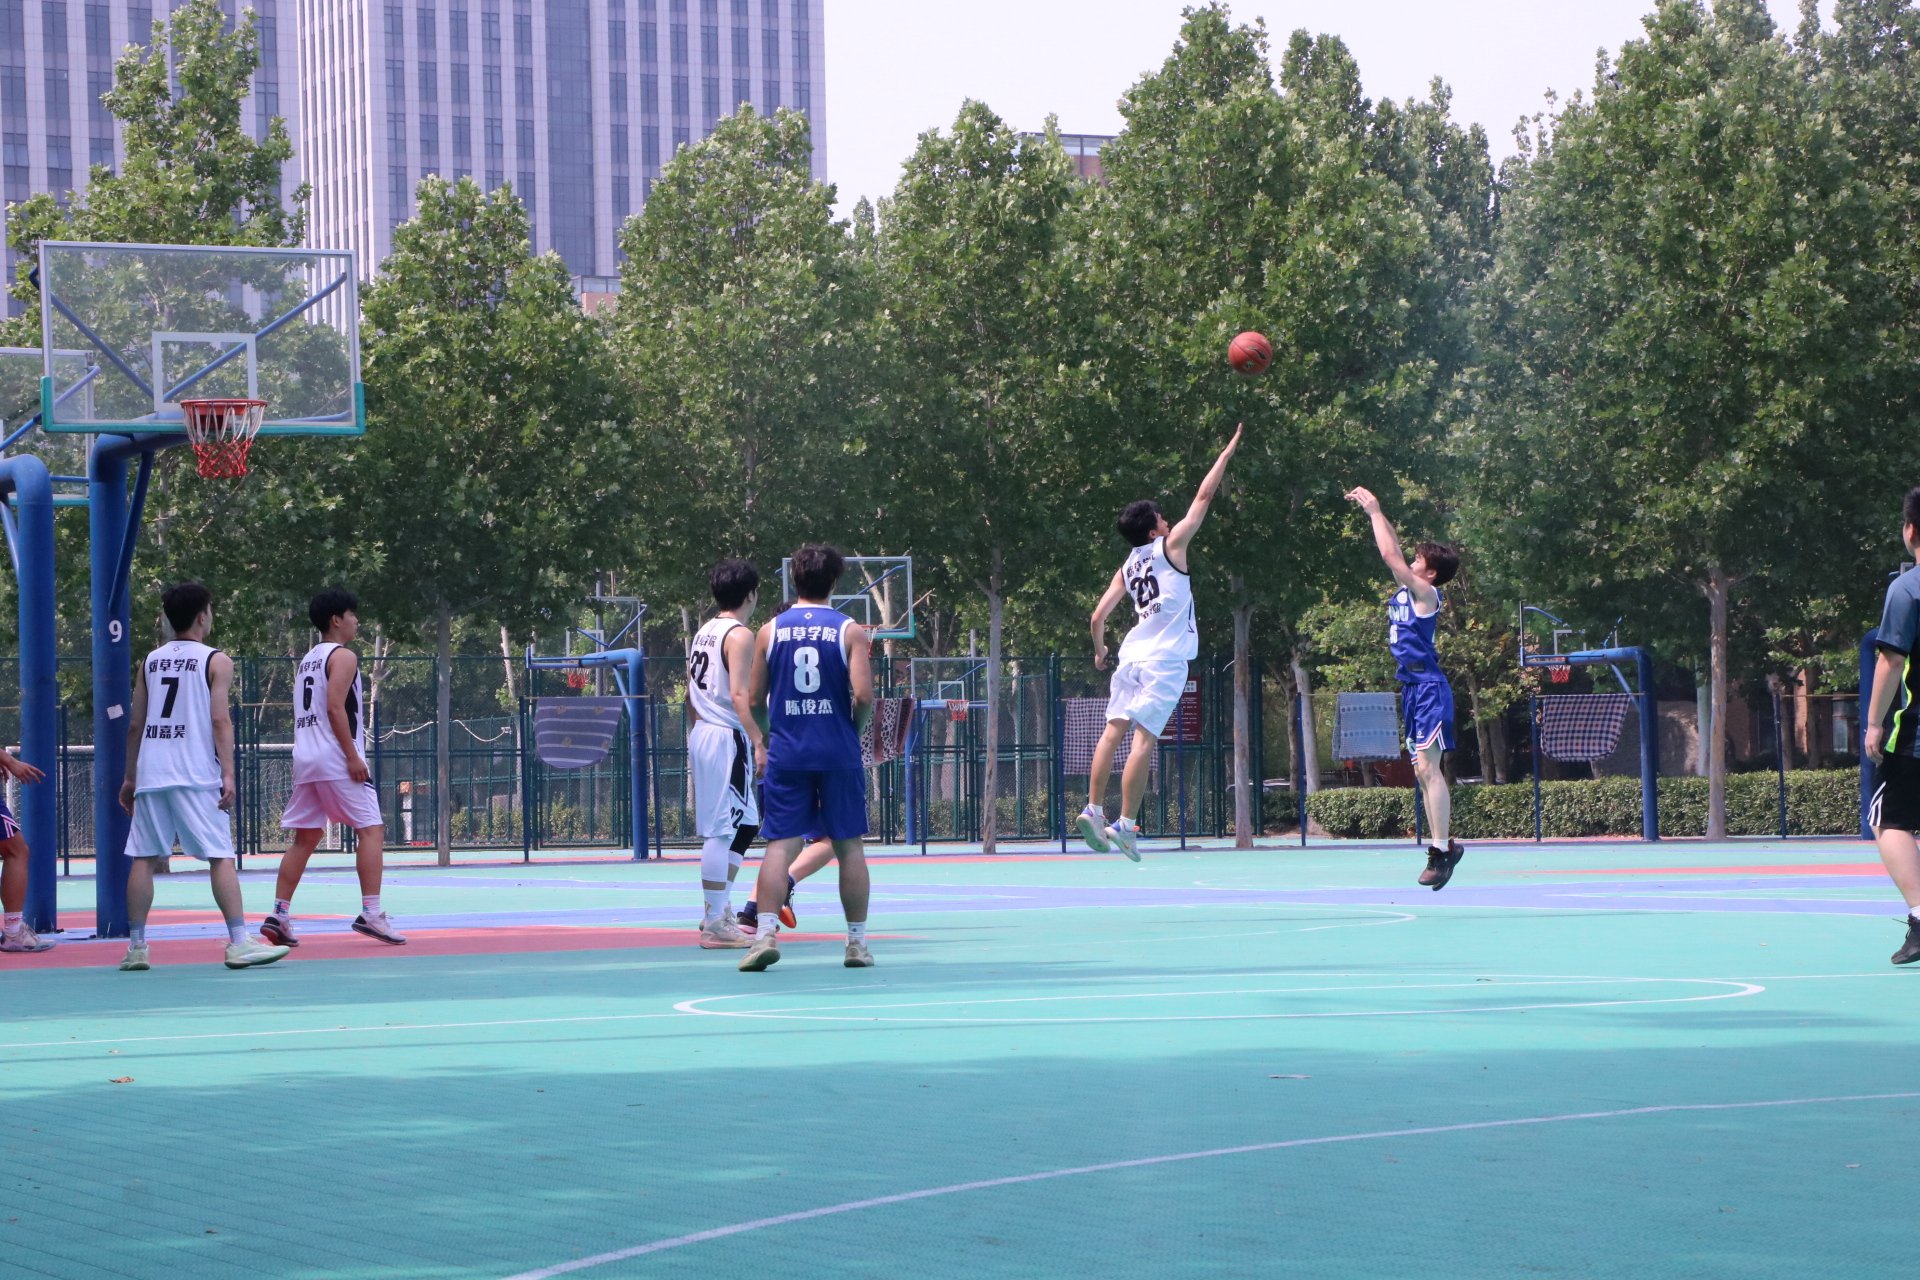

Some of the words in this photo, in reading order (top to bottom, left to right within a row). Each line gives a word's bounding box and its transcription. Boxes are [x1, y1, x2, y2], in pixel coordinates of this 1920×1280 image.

[108, 619, 123, 643] 9
[776, 625, 838, 643] 烟草学院
[148, 658, 199, 674] 烟草学院
[793, 646, 821, 693] 8
[160, 676, 180, 719] 7
[303, 676, 314, 712] 6
[785, 698, 833, 716] 陈俊杰
[145, 724, 186, 739] 刘嘉昊
